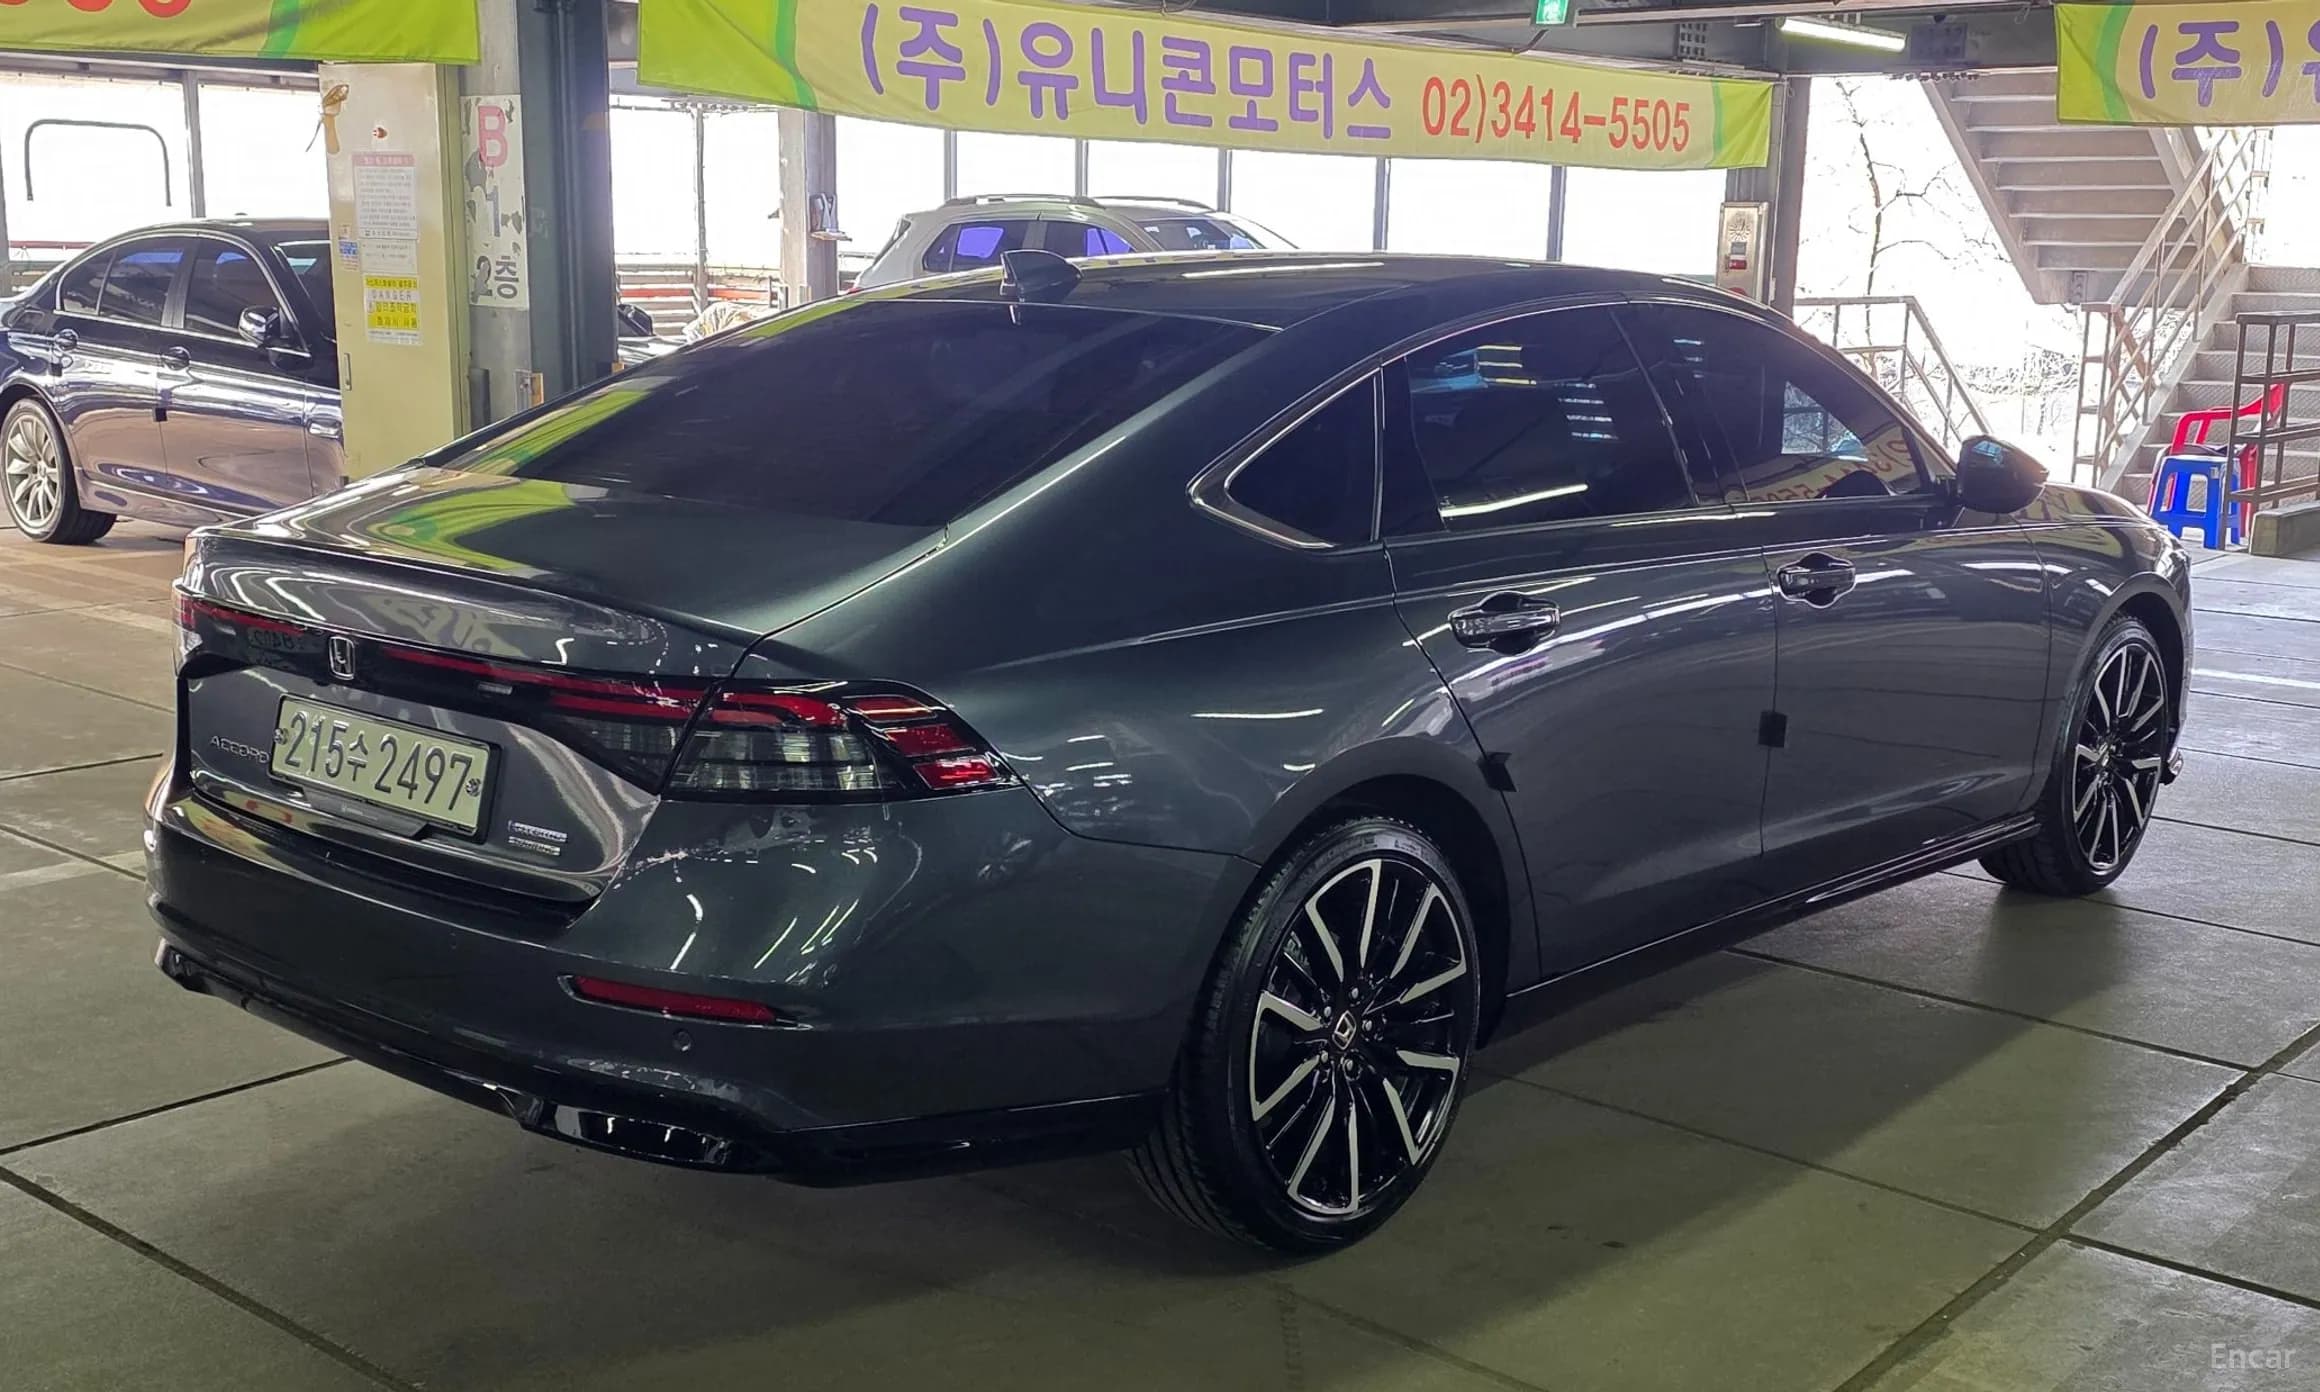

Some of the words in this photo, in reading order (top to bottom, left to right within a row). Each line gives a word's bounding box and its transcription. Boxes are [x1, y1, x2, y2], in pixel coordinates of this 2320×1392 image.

[861, 3, 1392, 140] (주)유니콘모터스
[1422, 74, 1690, 152] 02)3414-5505
[209, 735, 270, 764] ACCORD
